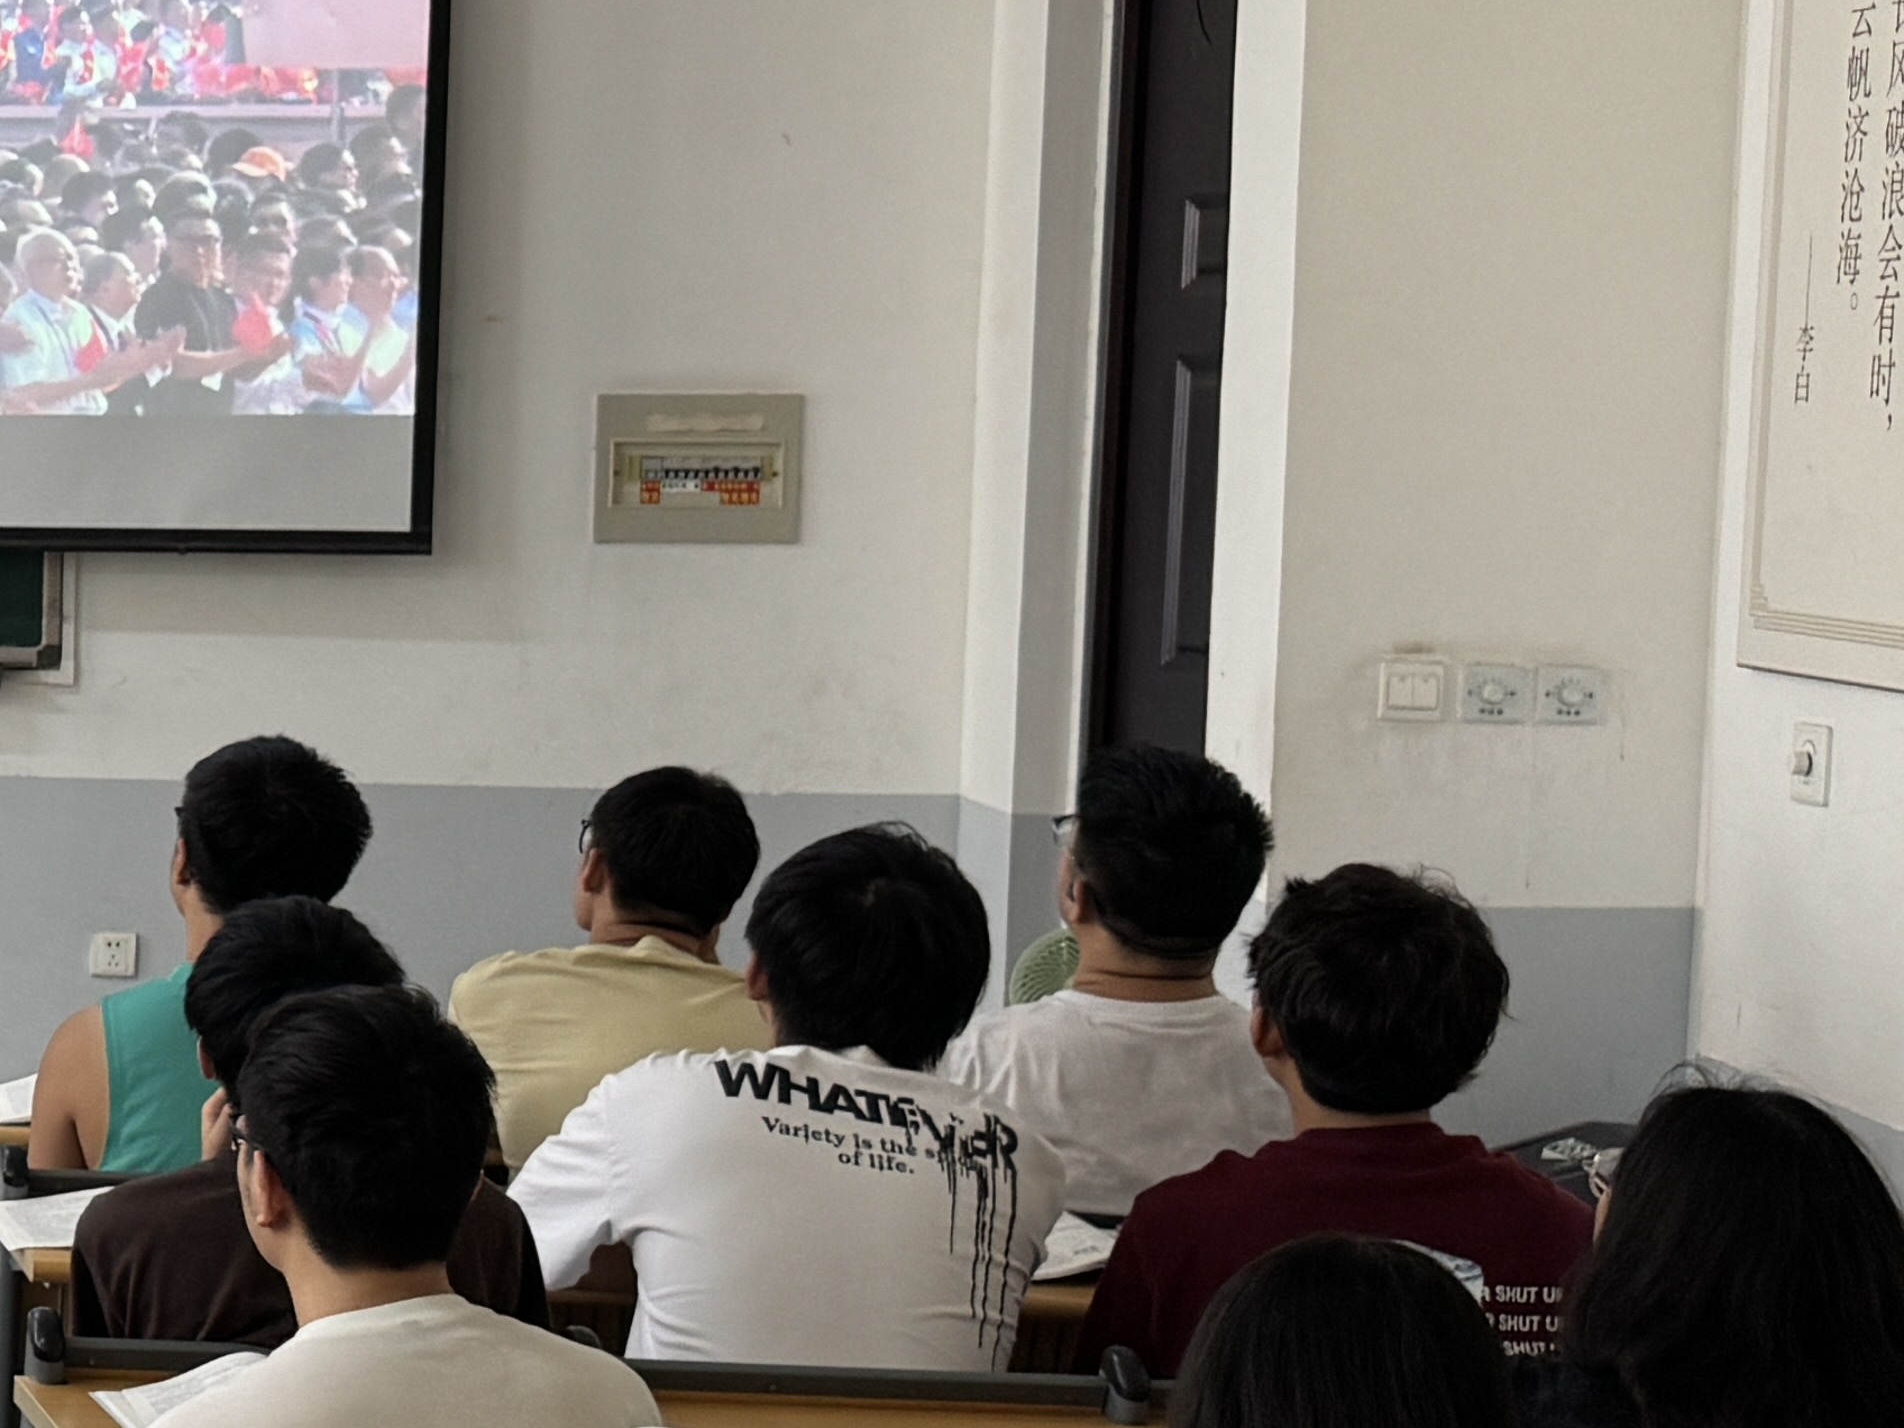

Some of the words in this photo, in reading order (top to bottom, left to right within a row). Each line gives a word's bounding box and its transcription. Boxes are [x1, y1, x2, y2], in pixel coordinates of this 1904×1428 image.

[838, 1151, 861, 1167] of
[1494, 1284, 1539, 1304] SHUT
[1498, 1313, 1542, 1333] SHUT
